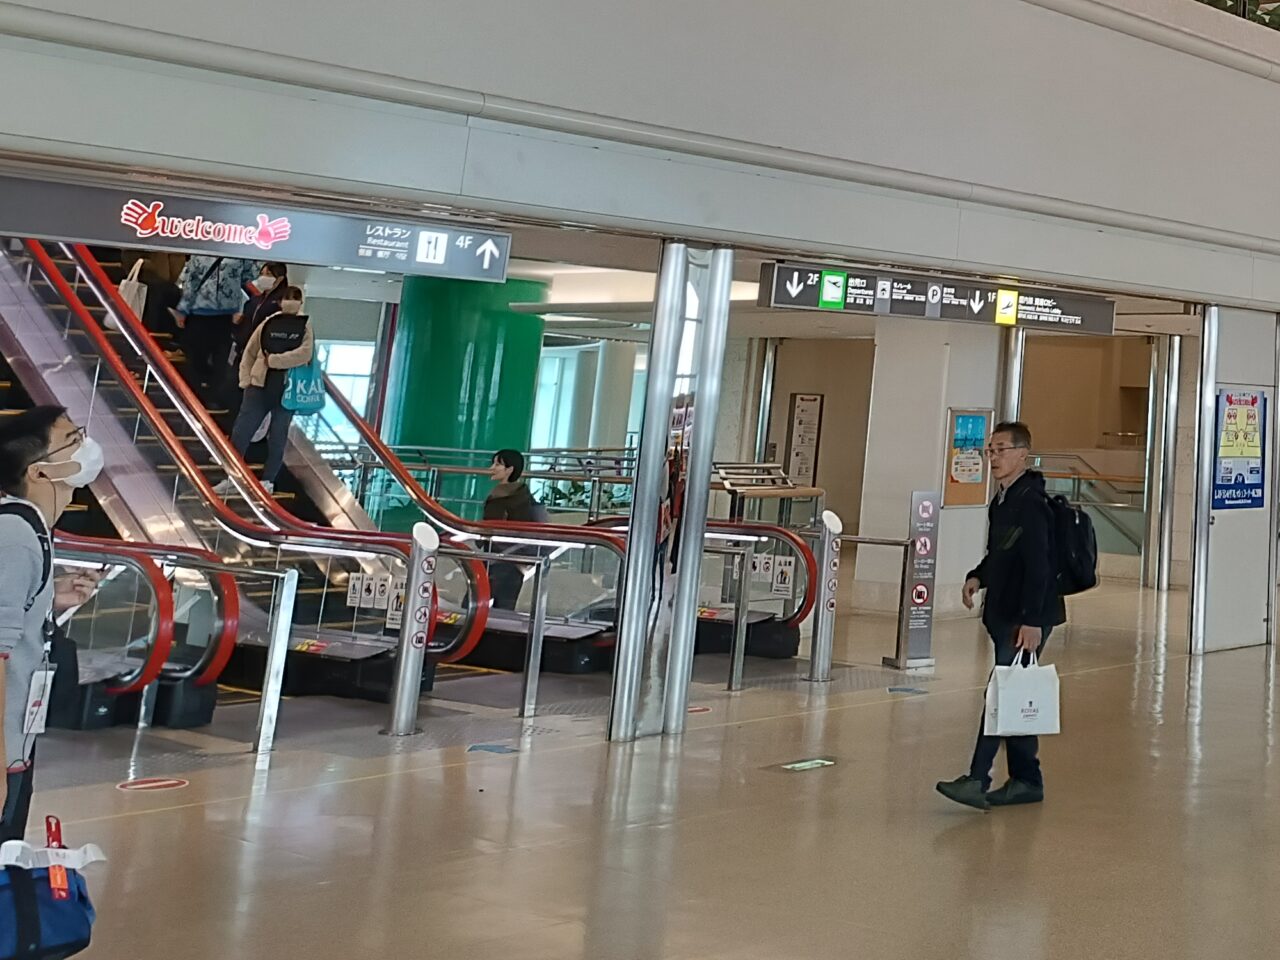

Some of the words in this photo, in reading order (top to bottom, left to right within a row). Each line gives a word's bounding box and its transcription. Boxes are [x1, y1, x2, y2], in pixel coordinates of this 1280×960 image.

[157, 216, 257, 245] welcome
[366, 225, 412, 239] レストラン
[456, 235, 474, 249] 4F
[367, 236, 409, 249] Restaurant
[806, 273, 820, 285] 2F
[987, 292, 997, 303] 1F
